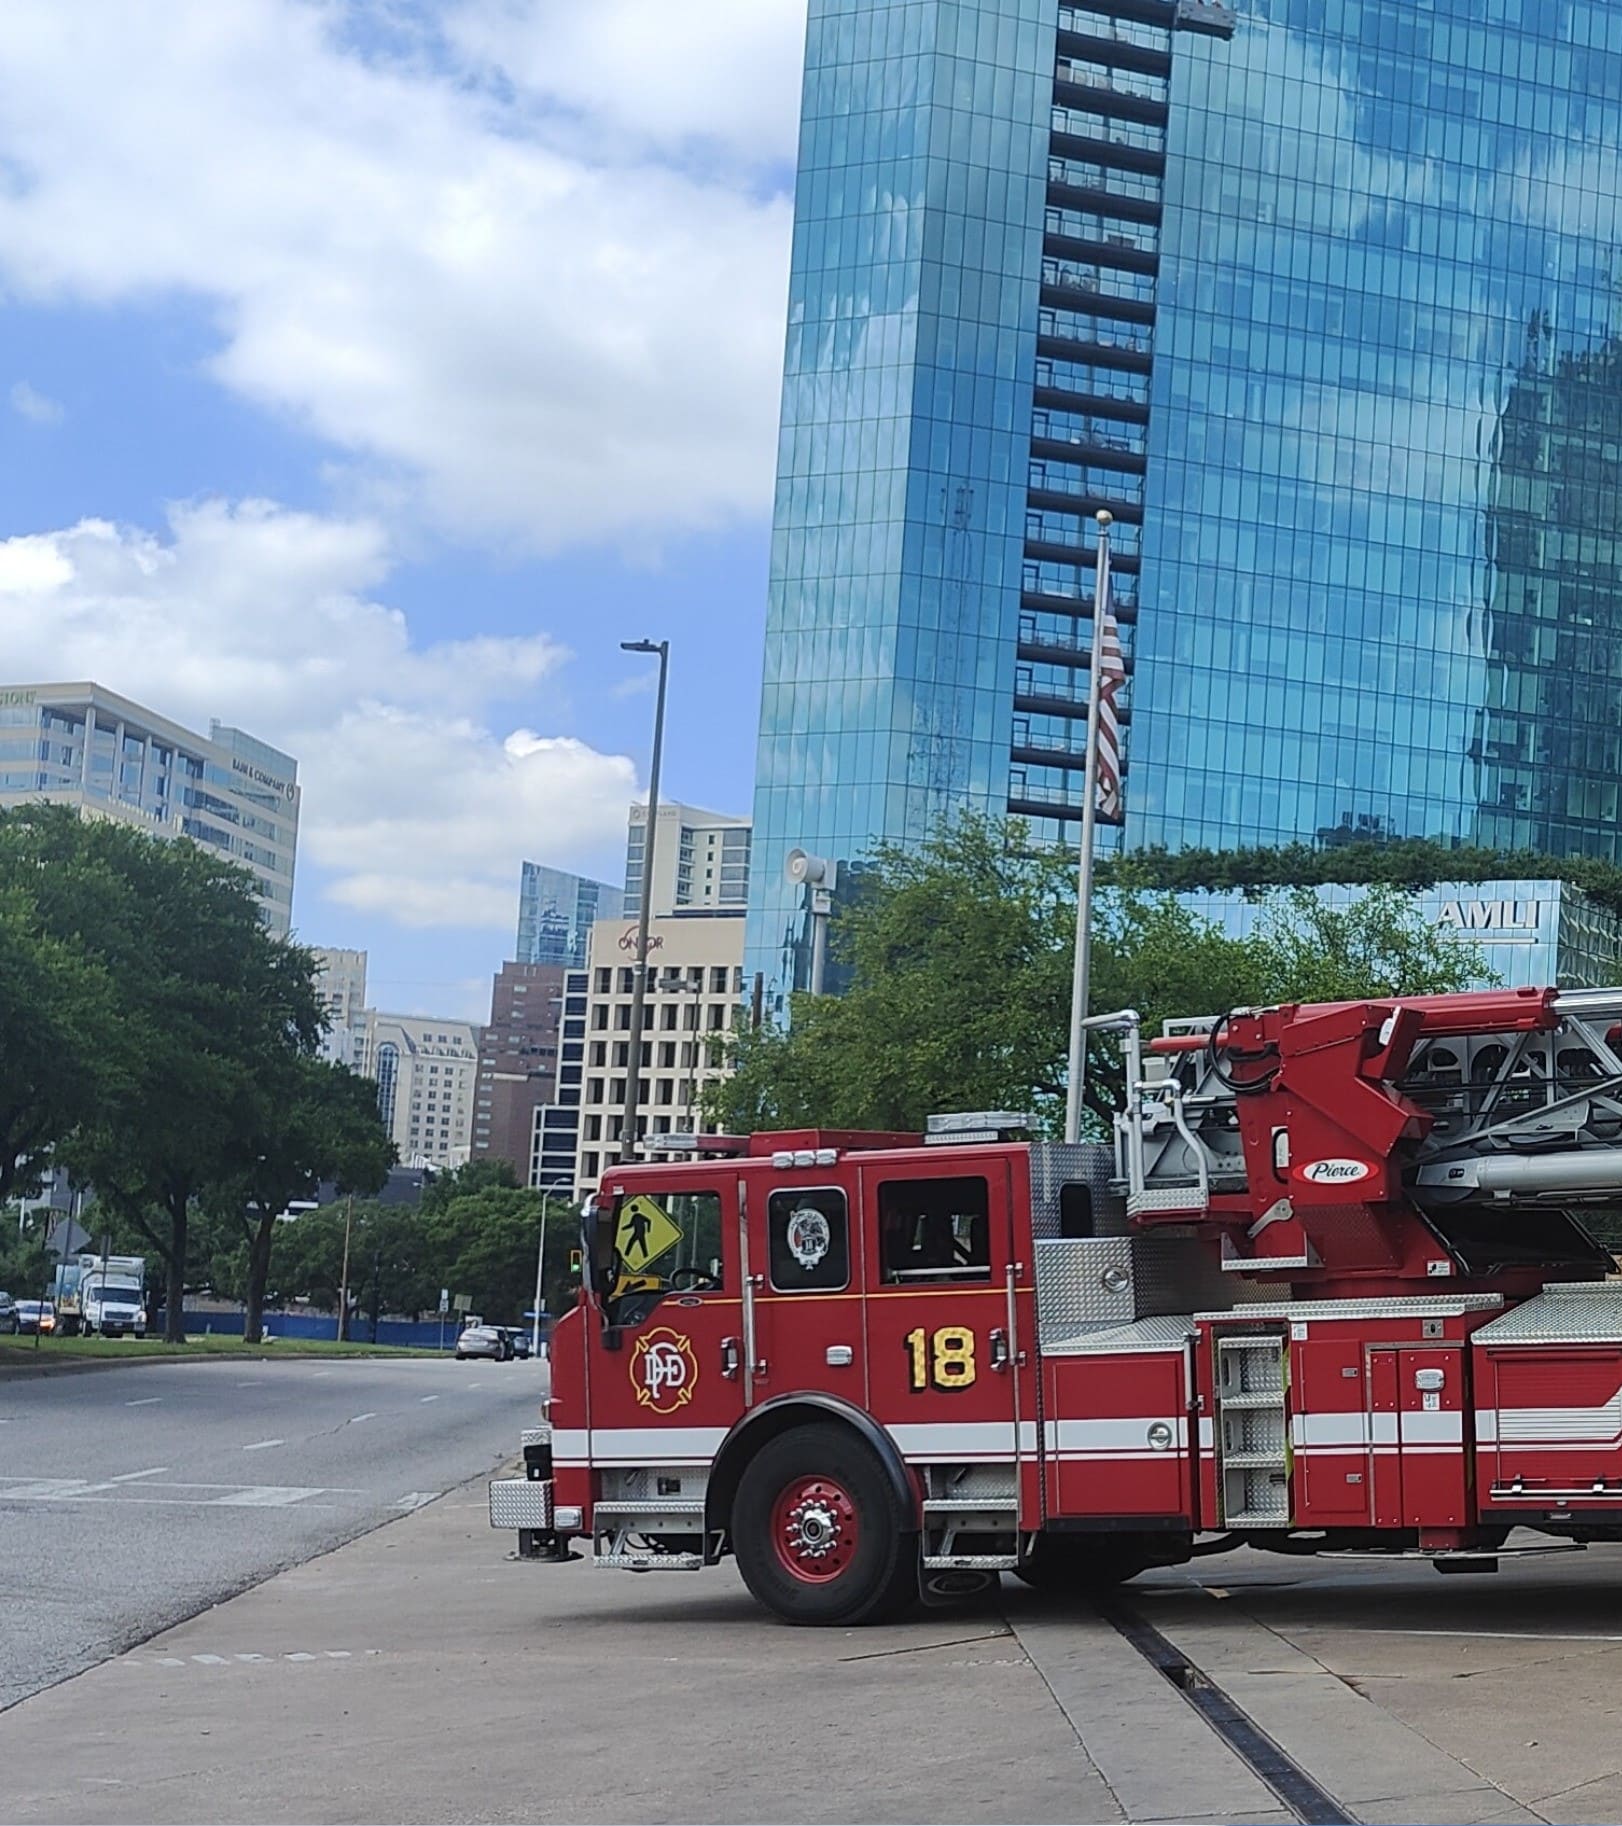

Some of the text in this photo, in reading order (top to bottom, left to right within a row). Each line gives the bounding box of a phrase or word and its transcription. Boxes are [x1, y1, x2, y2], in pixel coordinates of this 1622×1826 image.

[1437, 900, 1539, 929] AMLI
[618, 935, 665, 951] ONOR
[1311, 1161, 1361, 1180] Pierce
[907, 1327, 977, 1391] 18
